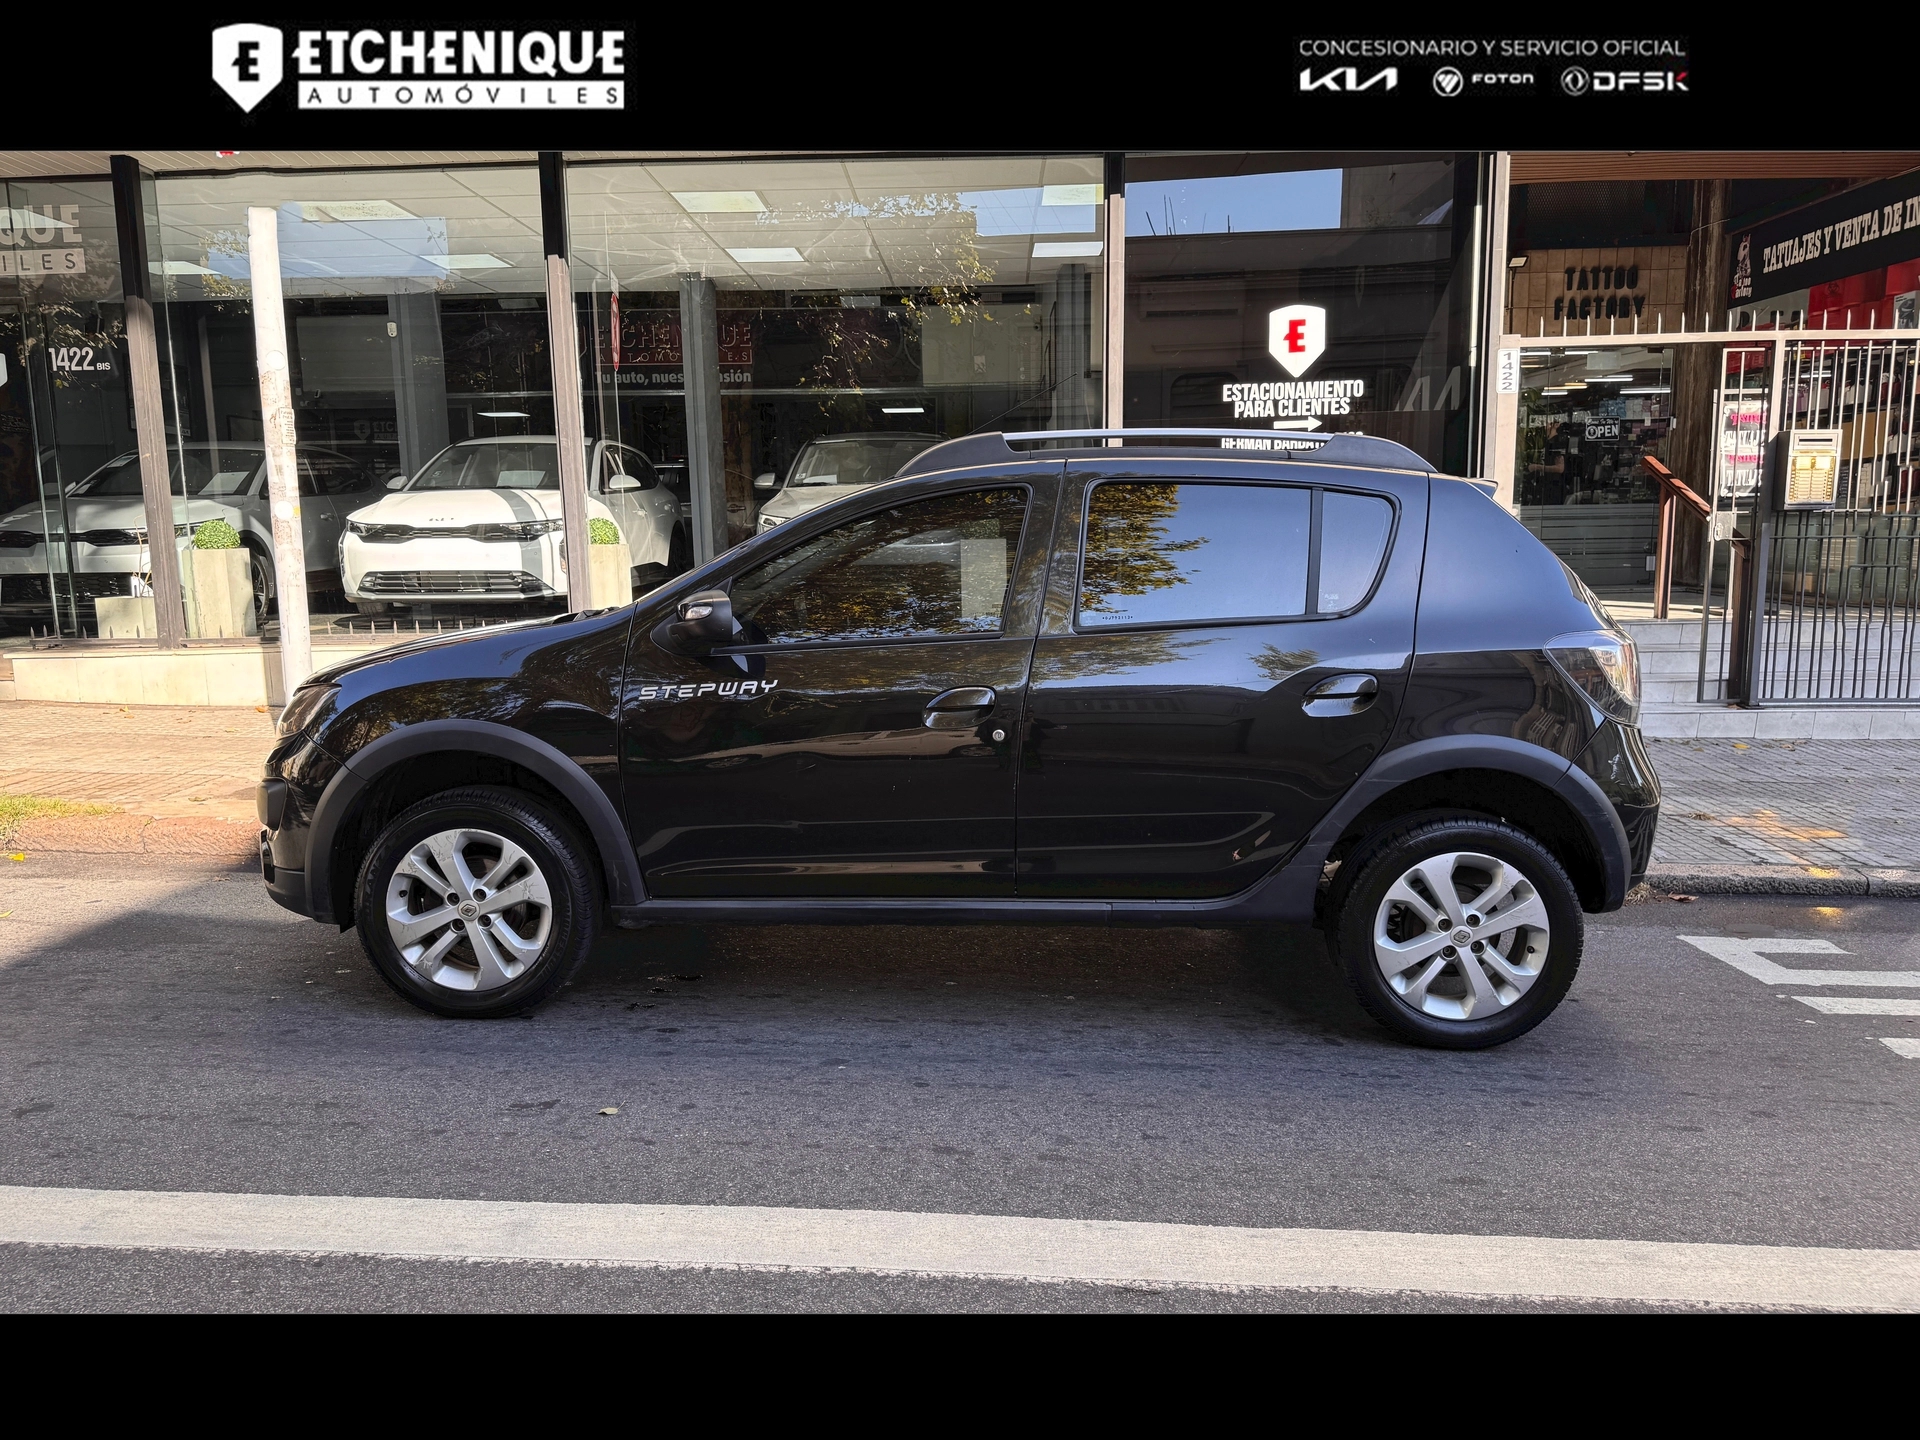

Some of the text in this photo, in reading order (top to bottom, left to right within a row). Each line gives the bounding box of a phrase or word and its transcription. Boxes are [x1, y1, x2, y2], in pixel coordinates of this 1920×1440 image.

[1763, 229, 1822, 274] TATUAJES
[1823, 225, 1834, 255] Y
[1834, 209, 1880, 251] VENTA
[1881, 201, 1903, 237] DE
[1565, 266, 1639, 291] TATTOO
[1554, 296, 1646, 320] FACTORY
[48, 346, 111, 371] 1422 BIS
[616, 371, 649, 386] auto,
[652, 373, 685, 384] nues
[1501, 352, 1514, 391] 1422
[1222, 380, 1364, 402] ESTACIONAMIENTO
[1234, 397, 1350, 419] PARA CLIENTES
[1586, 425, 1619, 439] OPEN
[638, 679, 779, 700] STEPWAY
